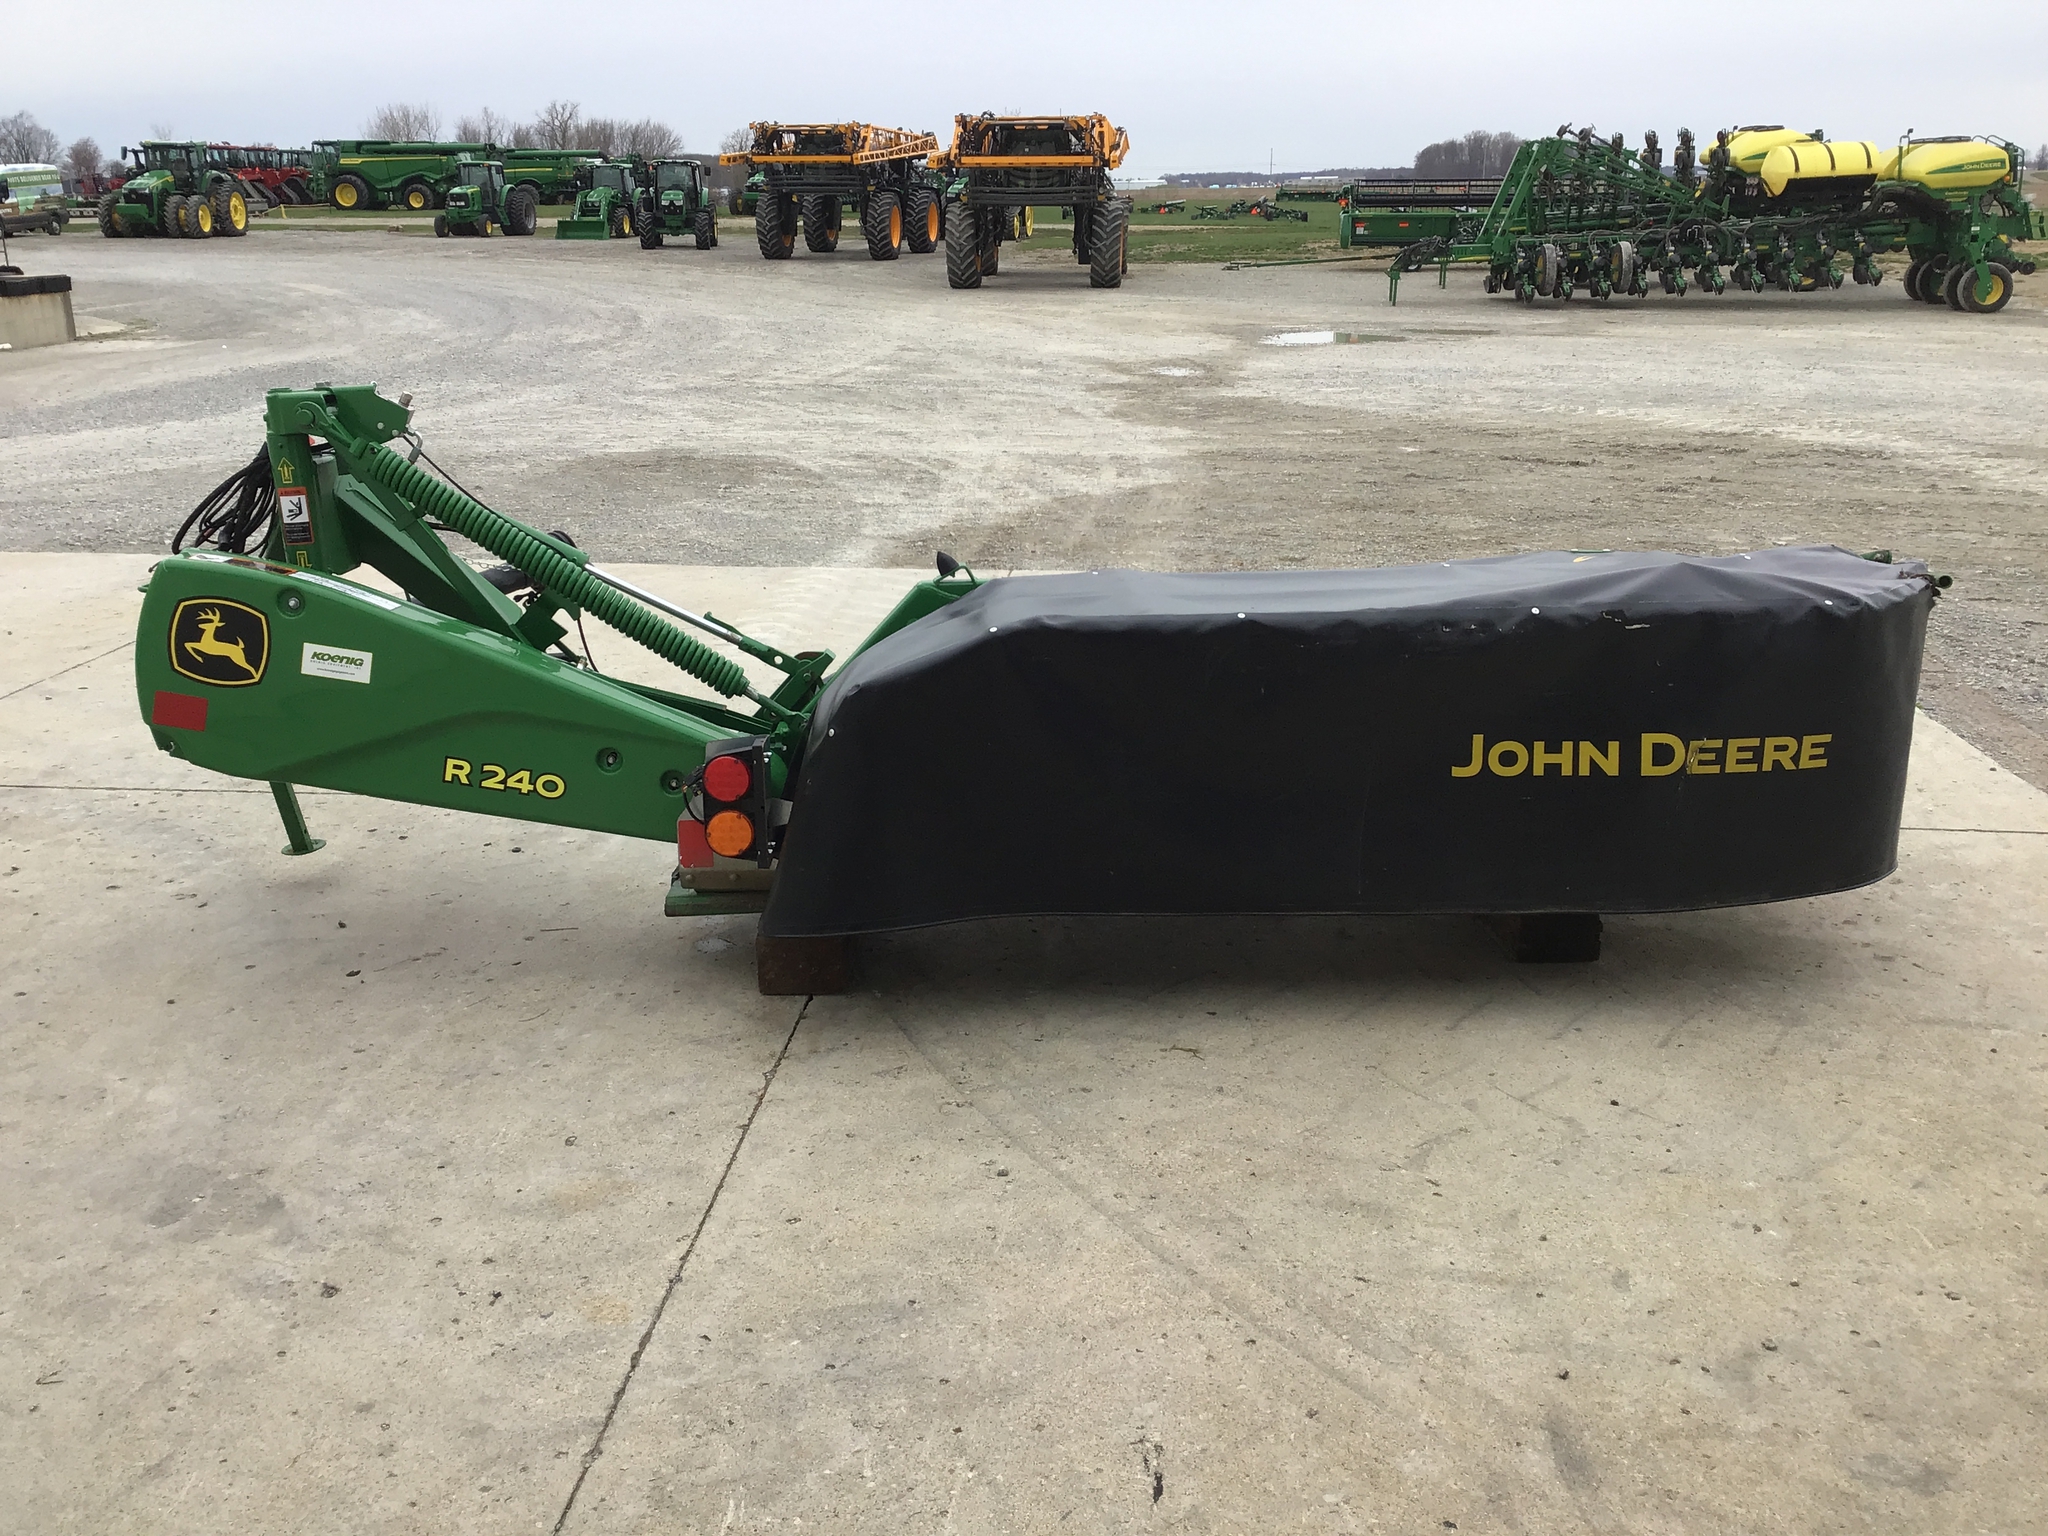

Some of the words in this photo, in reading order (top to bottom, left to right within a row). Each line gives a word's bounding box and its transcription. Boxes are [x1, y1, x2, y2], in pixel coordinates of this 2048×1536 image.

[1980, 161, 2002, 169] DEERE
[1451, 733, 1620, 777] JOHN
[1640, 732, 1833, 777] DEERE
[443, 757, 472, 786] R
[480, 764, 566, 799] 240
